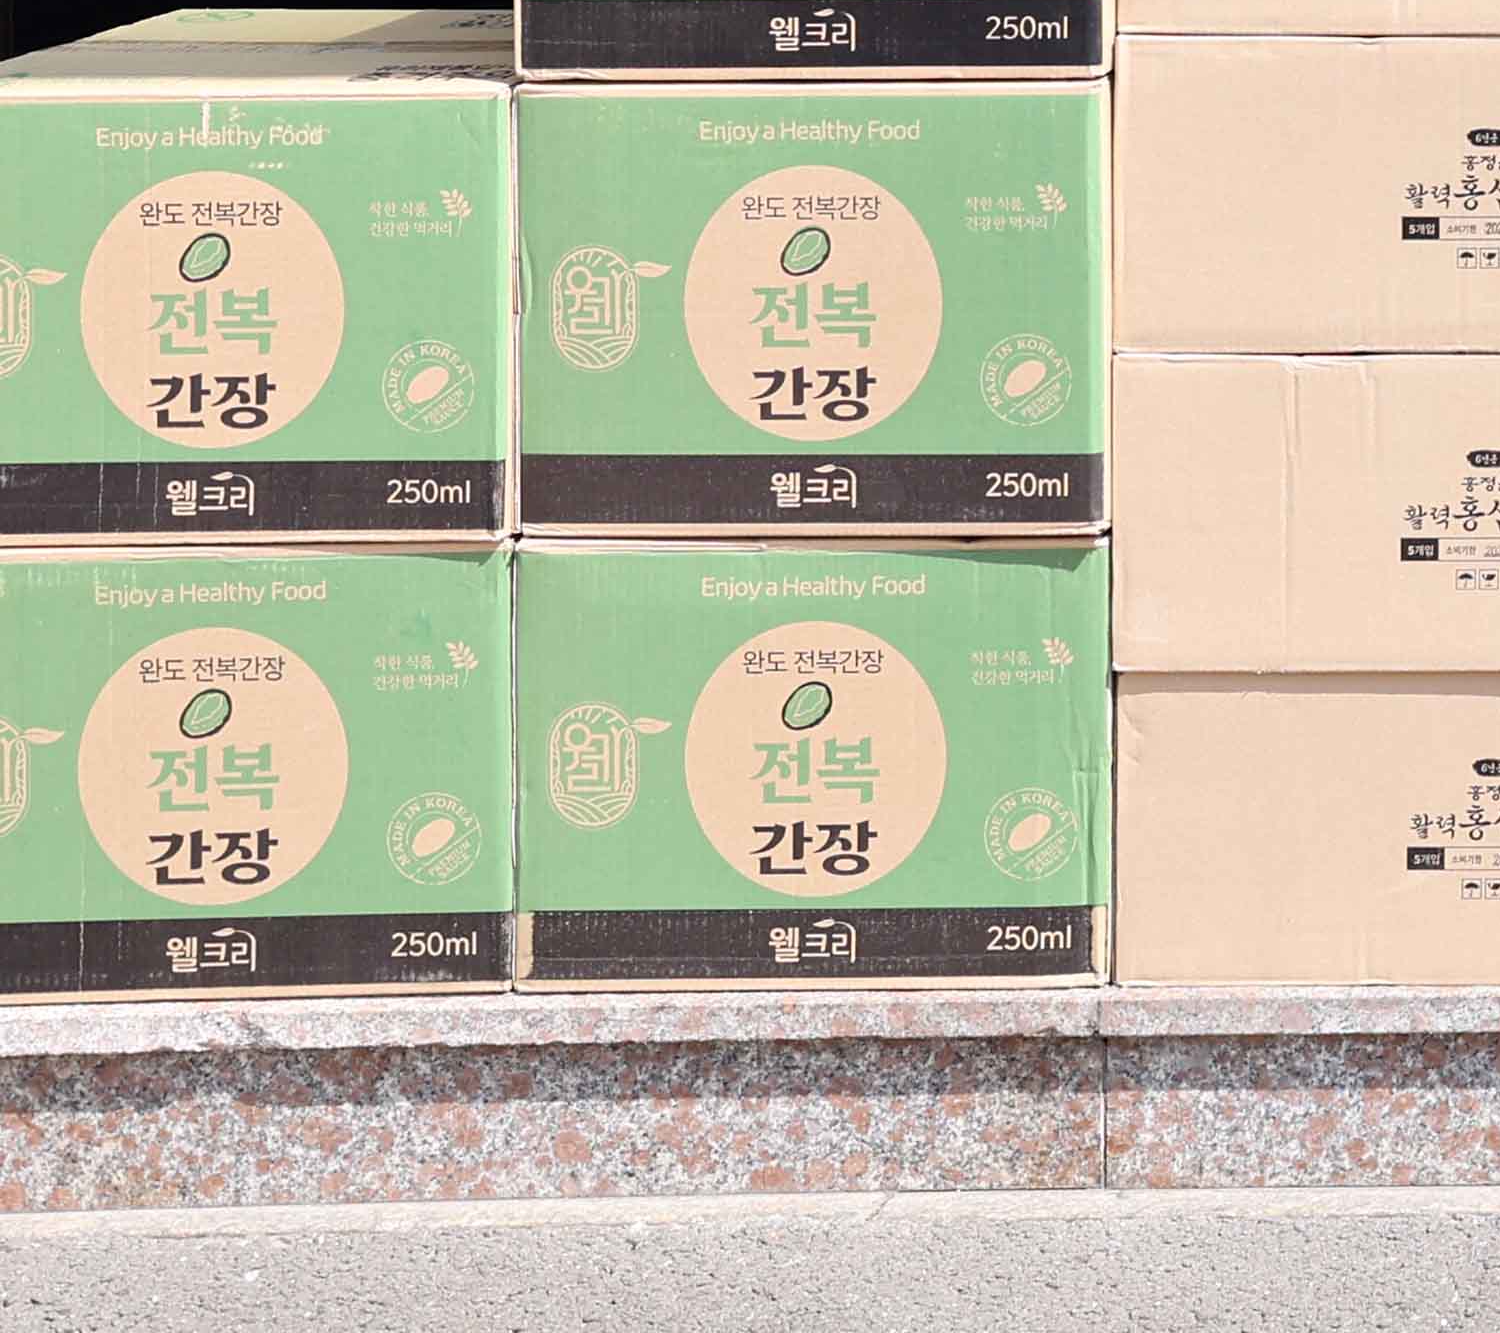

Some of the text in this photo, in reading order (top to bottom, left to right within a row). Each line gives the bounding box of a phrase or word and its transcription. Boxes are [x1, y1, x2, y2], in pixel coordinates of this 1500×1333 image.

[768, 8, 856, 52] 웰크리
[984, 17, 1068, 41] 250ml
[145, 289, 277, 355] 전복
[749, 282, 877, 348] 전복
[145, 373, 276, 430] 간장
[749, 366, 877, 422] 간장
[386, 479, 471, 504] 250ml
[985, 473, 1069, 498] 250ml
[145, 744, 280, 812] 전복
[749, 737, 879, 803] 전복
[145, 829, 279, 886] 간장
[748, 821, 878, 877] 간장
[390, 932, 478, 957] 250ml
